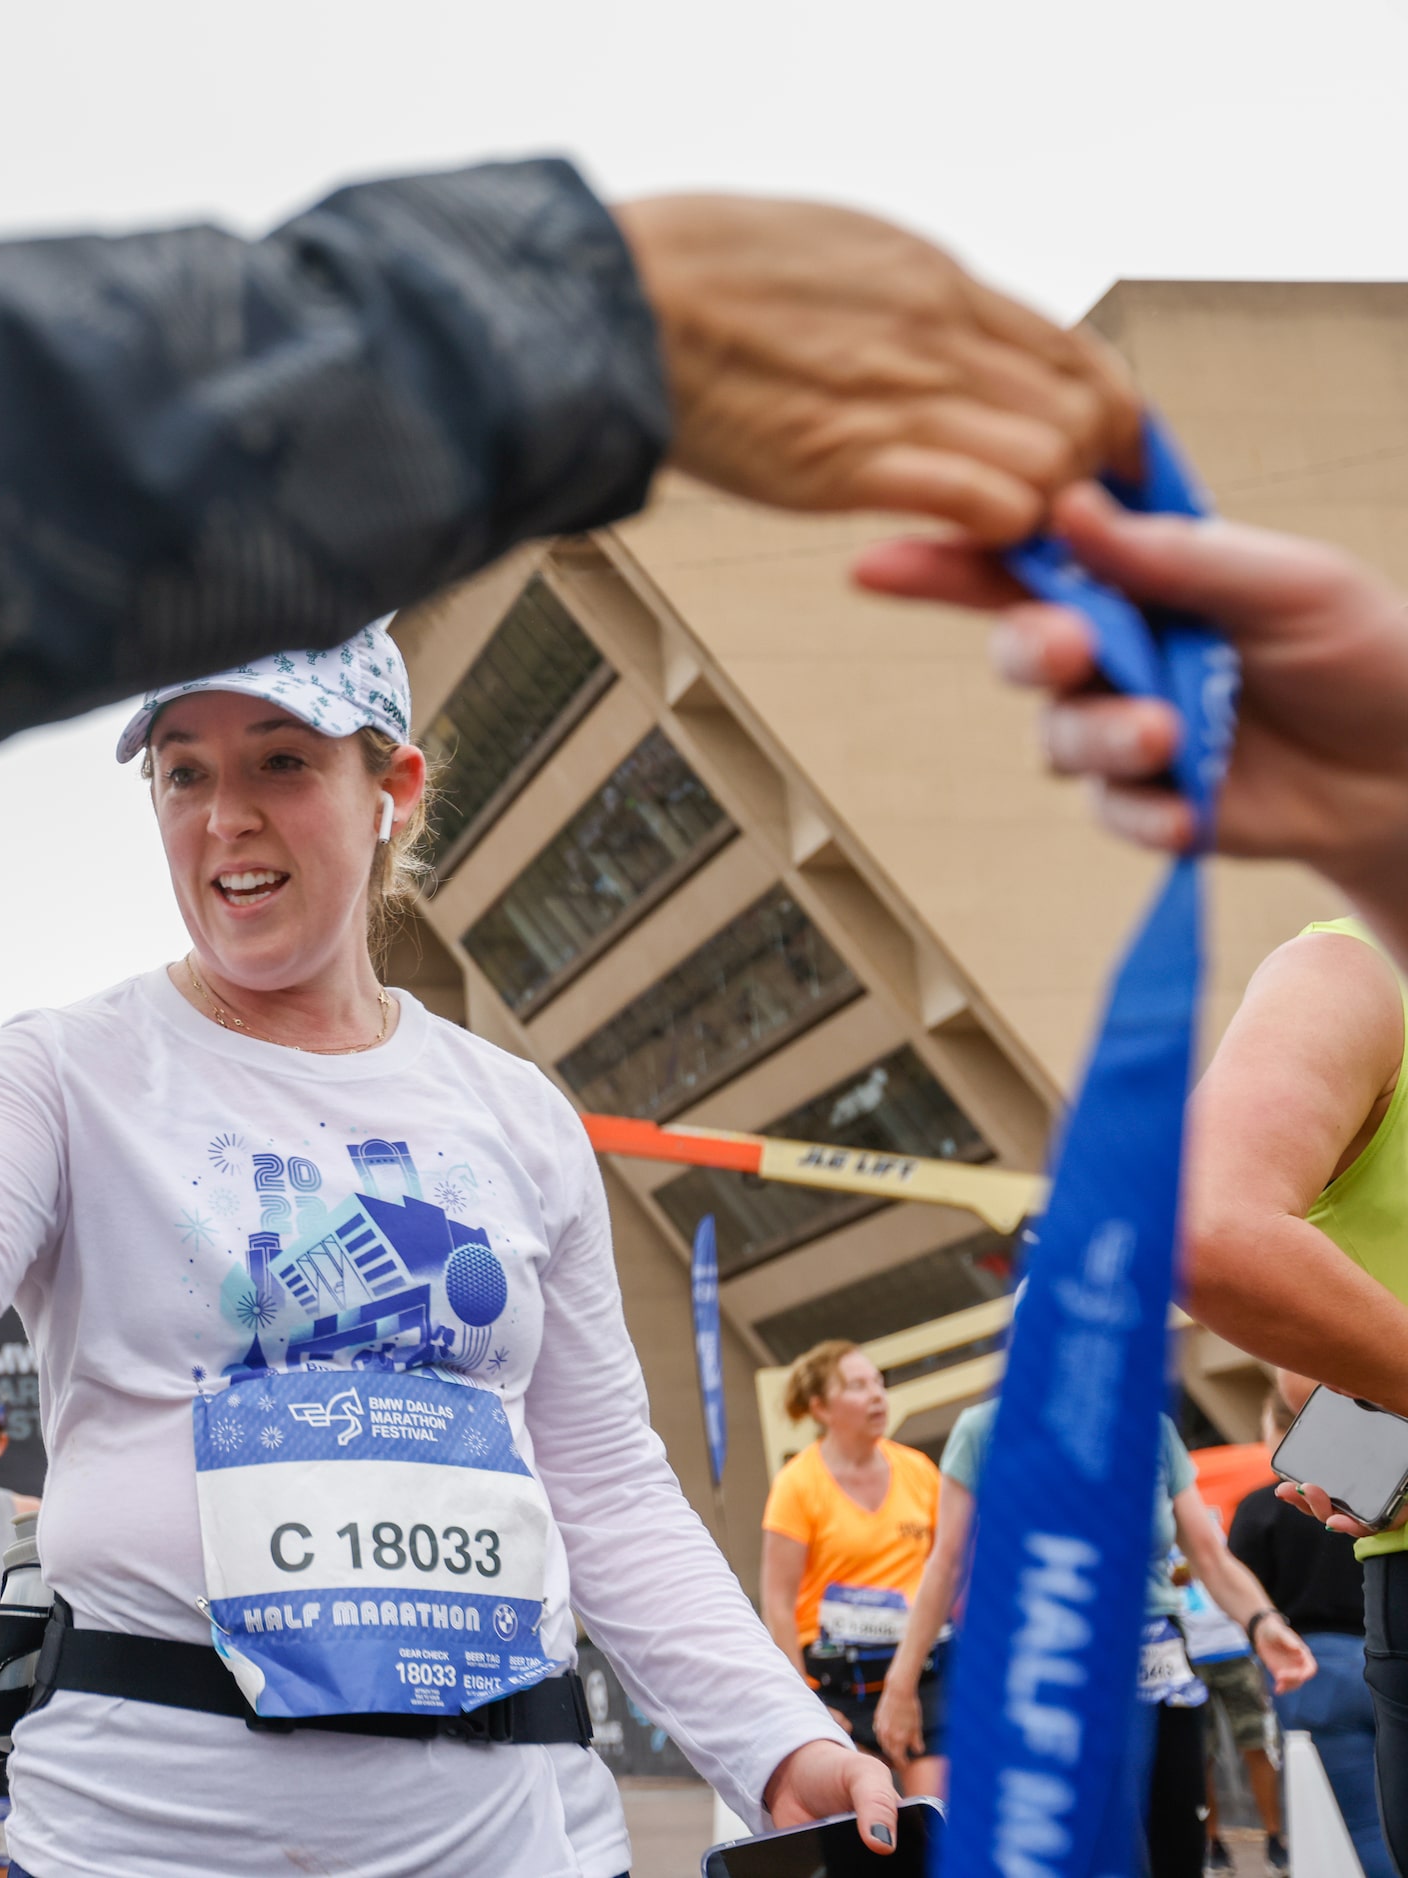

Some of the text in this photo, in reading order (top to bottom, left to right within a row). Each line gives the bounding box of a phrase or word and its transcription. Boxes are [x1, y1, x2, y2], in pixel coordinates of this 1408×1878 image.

[252, 1153, 322, 1192] 20
[259, 1194, 327, 1234] 22
[368, 1396, 454, 1420] BMW DALLAS
[370, 1410, 447, 1431] MARATHON
[372, 1425, 439, 1442] FESTIVAL
[270, 1522, 502, 1578] C 18033
[243, 1600, 481, 1633] HALF MARATHON
[399, 1648, 450, 1661] GEAR CHECK
[464, 1651, 485, 1663] BEER
[1004, 1531, 1101, 1767] HALF
[395, 1662, 457, 1687] 18033
[463, 1674, 503, 1690] EIGHT
